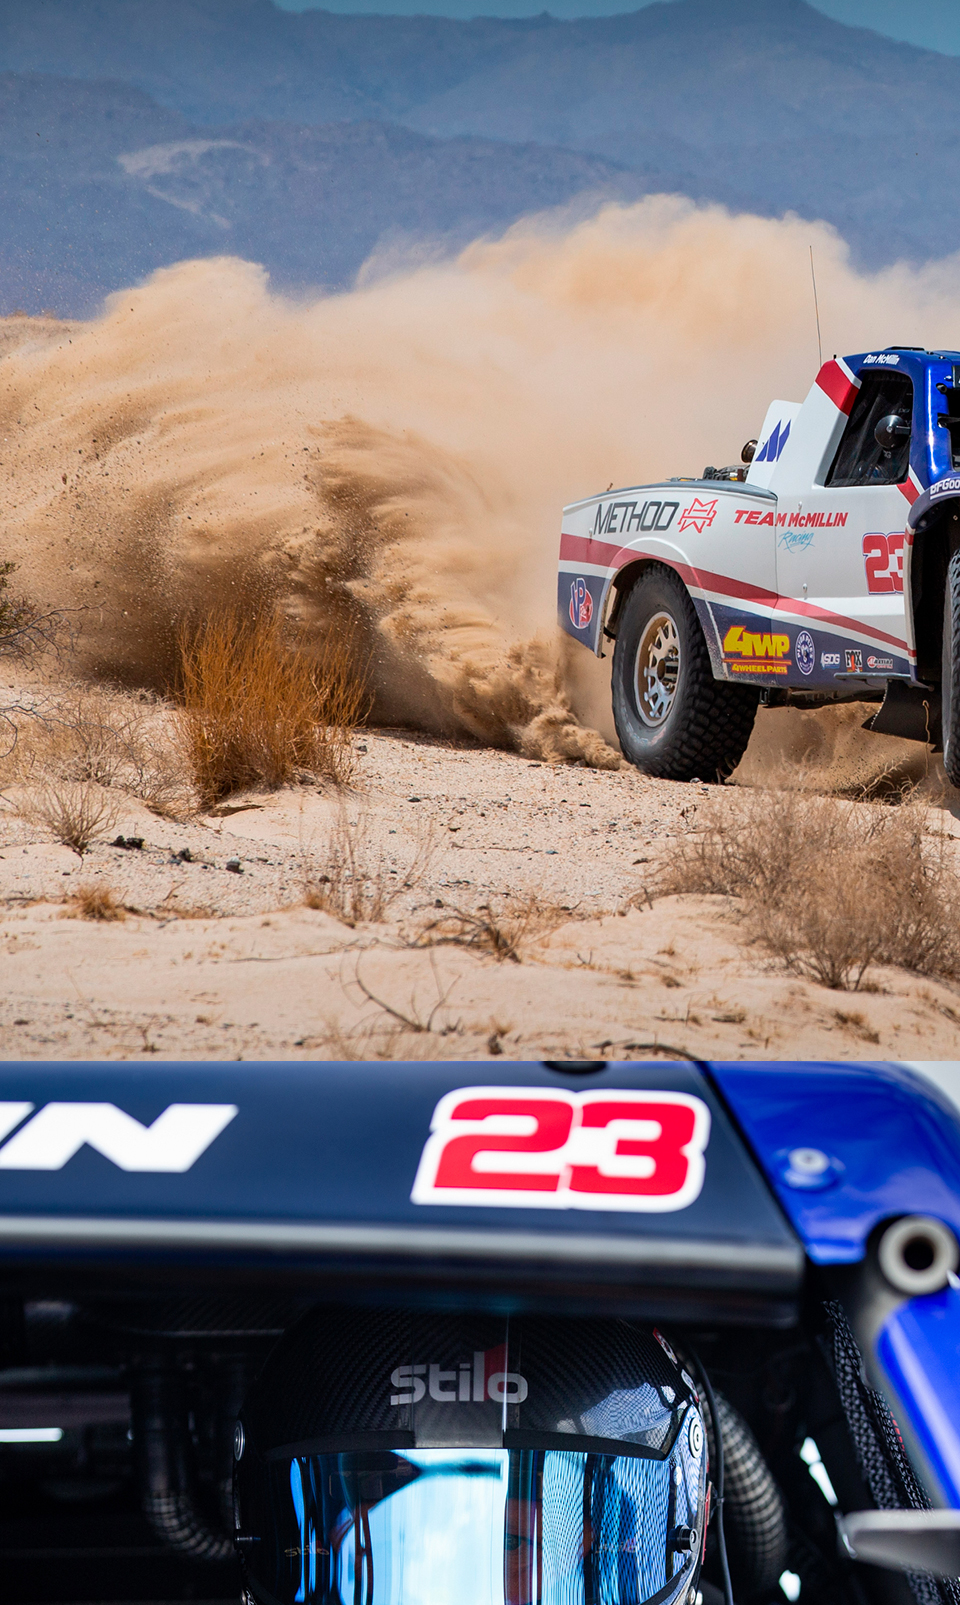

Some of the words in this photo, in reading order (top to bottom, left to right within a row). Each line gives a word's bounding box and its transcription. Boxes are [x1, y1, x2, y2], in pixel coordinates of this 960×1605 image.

[593, 501, 680, 535] METHOD
[733, 509, 787, 527] TEAM
[778, 531, 817, 553] Racing
[723, 625, 790, 658] 4WP
[418, 1092, 704, 1206] 23
[390, 1350, 529, 1406] Stilo
